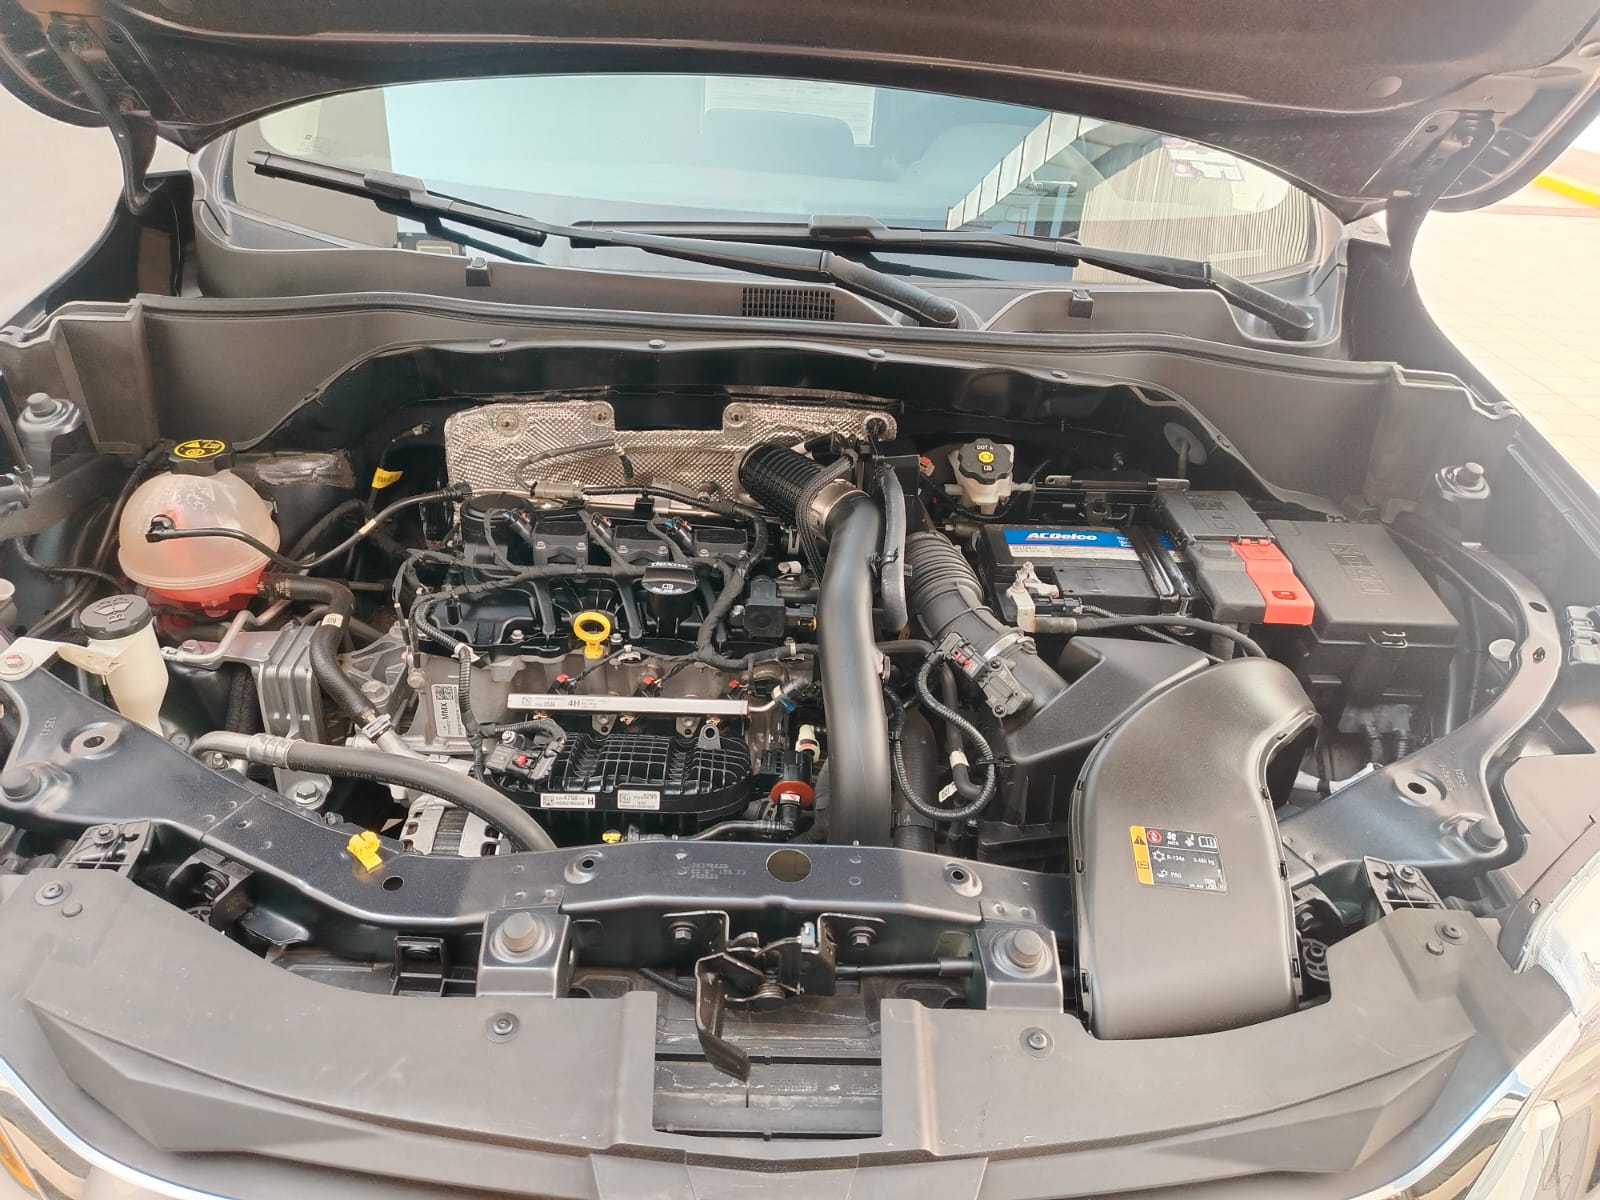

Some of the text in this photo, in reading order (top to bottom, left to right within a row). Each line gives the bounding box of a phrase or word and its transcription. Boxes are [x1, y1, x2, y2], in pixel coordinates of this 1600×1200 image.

[1026, 531, 1098, 541] ACDelco
[567, 699, 581, 708] 4H
[440, 702, 449, 720] MMX
[587, 797, 594, 806] H
